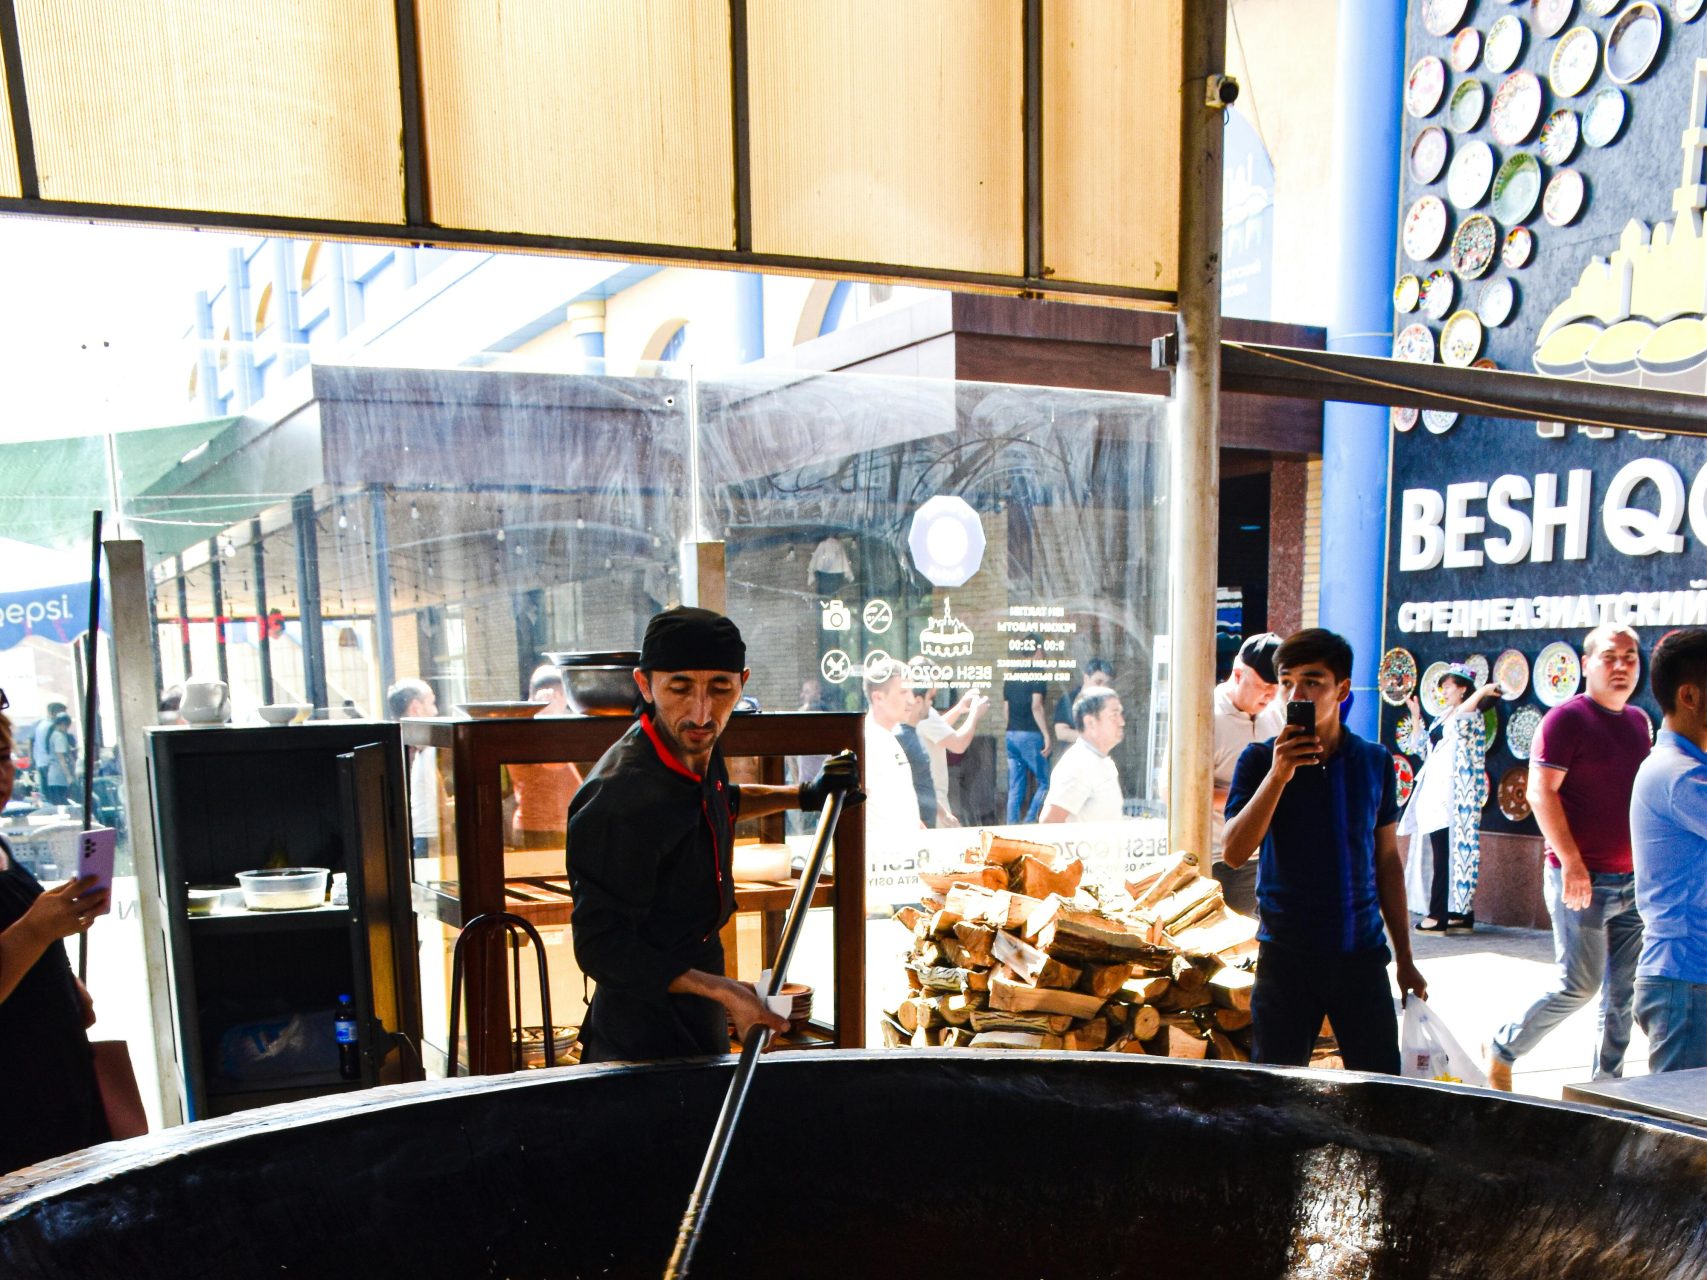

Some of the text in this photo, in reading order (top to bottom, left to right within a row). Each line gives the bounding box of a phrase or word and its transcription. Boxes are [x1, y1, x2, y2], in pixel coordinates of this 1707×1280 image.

[1400, 469, 1592, 571] BESH
[0, 594, 68, 628] epsi
[1398, 579, 1707, 637] СРЕДНЕАЗИАТСКИЙ
